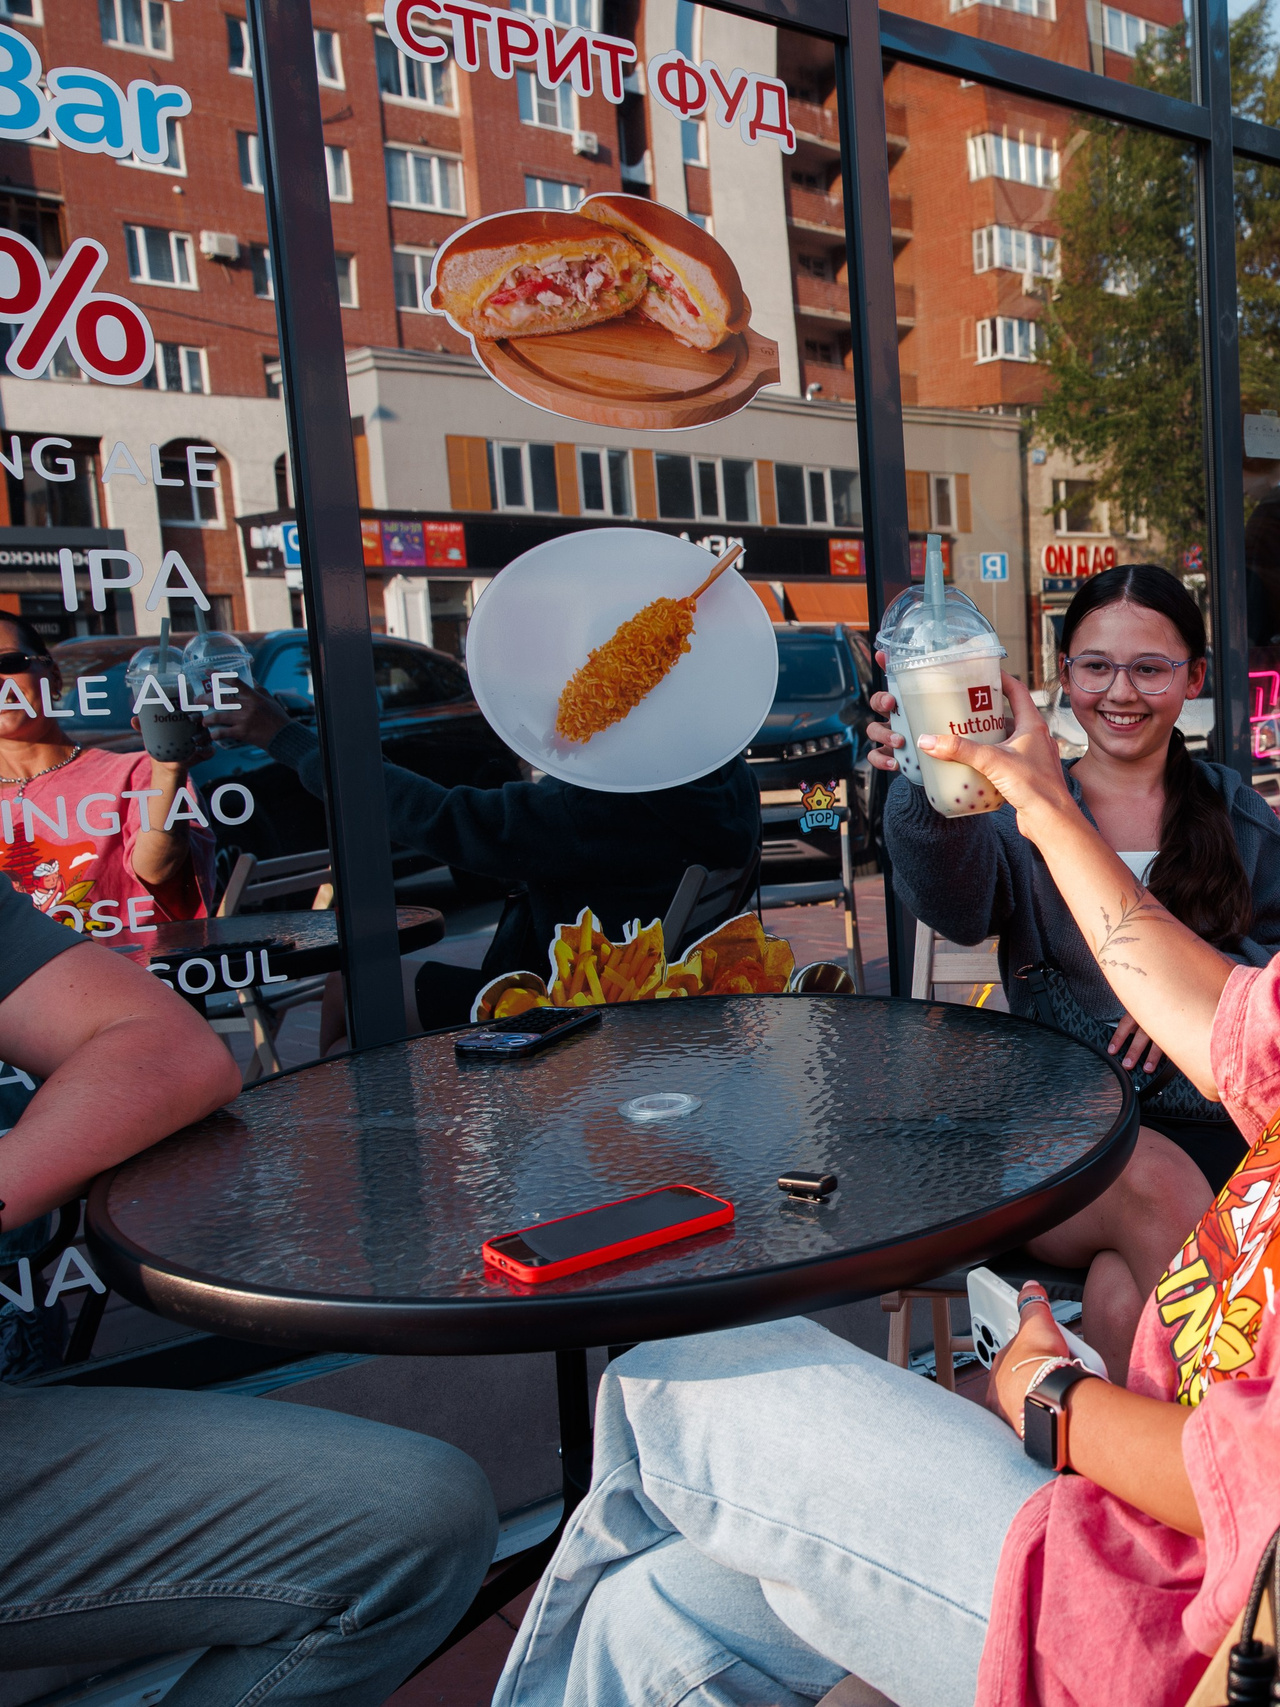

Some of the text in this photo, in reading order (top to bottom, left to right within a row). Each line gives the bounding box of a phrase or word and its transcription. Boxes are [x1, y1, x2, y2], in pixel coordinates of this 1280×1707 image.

[0, 28, 187, 158] Bar
[392, 0, 796, 152] СТРИТ ФУД
[102, 441, 220, 488] ALE
[59, 547, 211, 612] IPA
[133, 671, 243, 714] ALE
[808, 812, 832, 825] TOP
